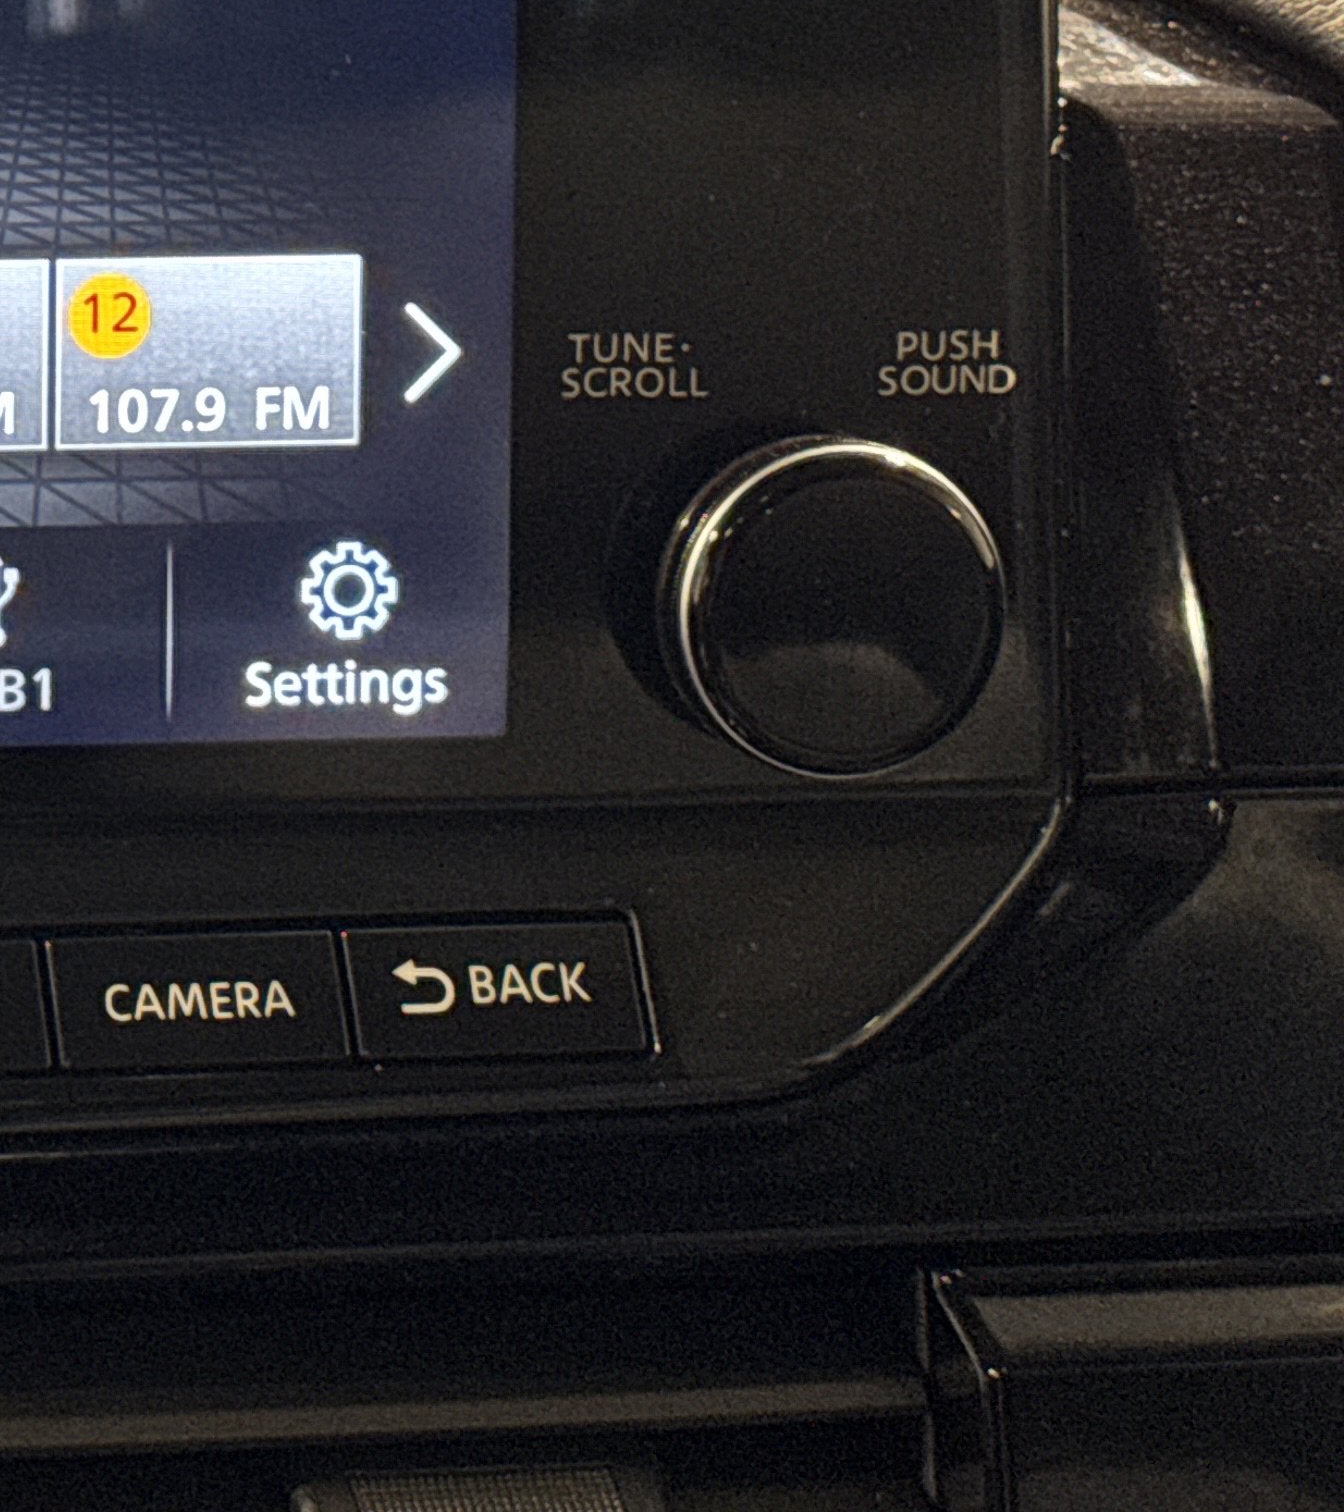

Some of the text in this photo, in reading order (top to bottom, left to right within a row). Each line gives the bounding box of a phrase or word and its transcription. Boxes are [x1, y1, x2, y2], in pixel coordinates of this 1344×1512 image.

[83, 291, 138, 336] 12
[897, 329, 1001, 360] PUSH
[560, 367, 708, 399] SCROLL
[879, 364, 1016, 397] SOUND
[89, 386, 330, 434] 107.9 FM
[245, 662, 448, 714] Settings
[103, 978, 296, 1024] CAMERA
[470, 960, 592, 1007] BACK
